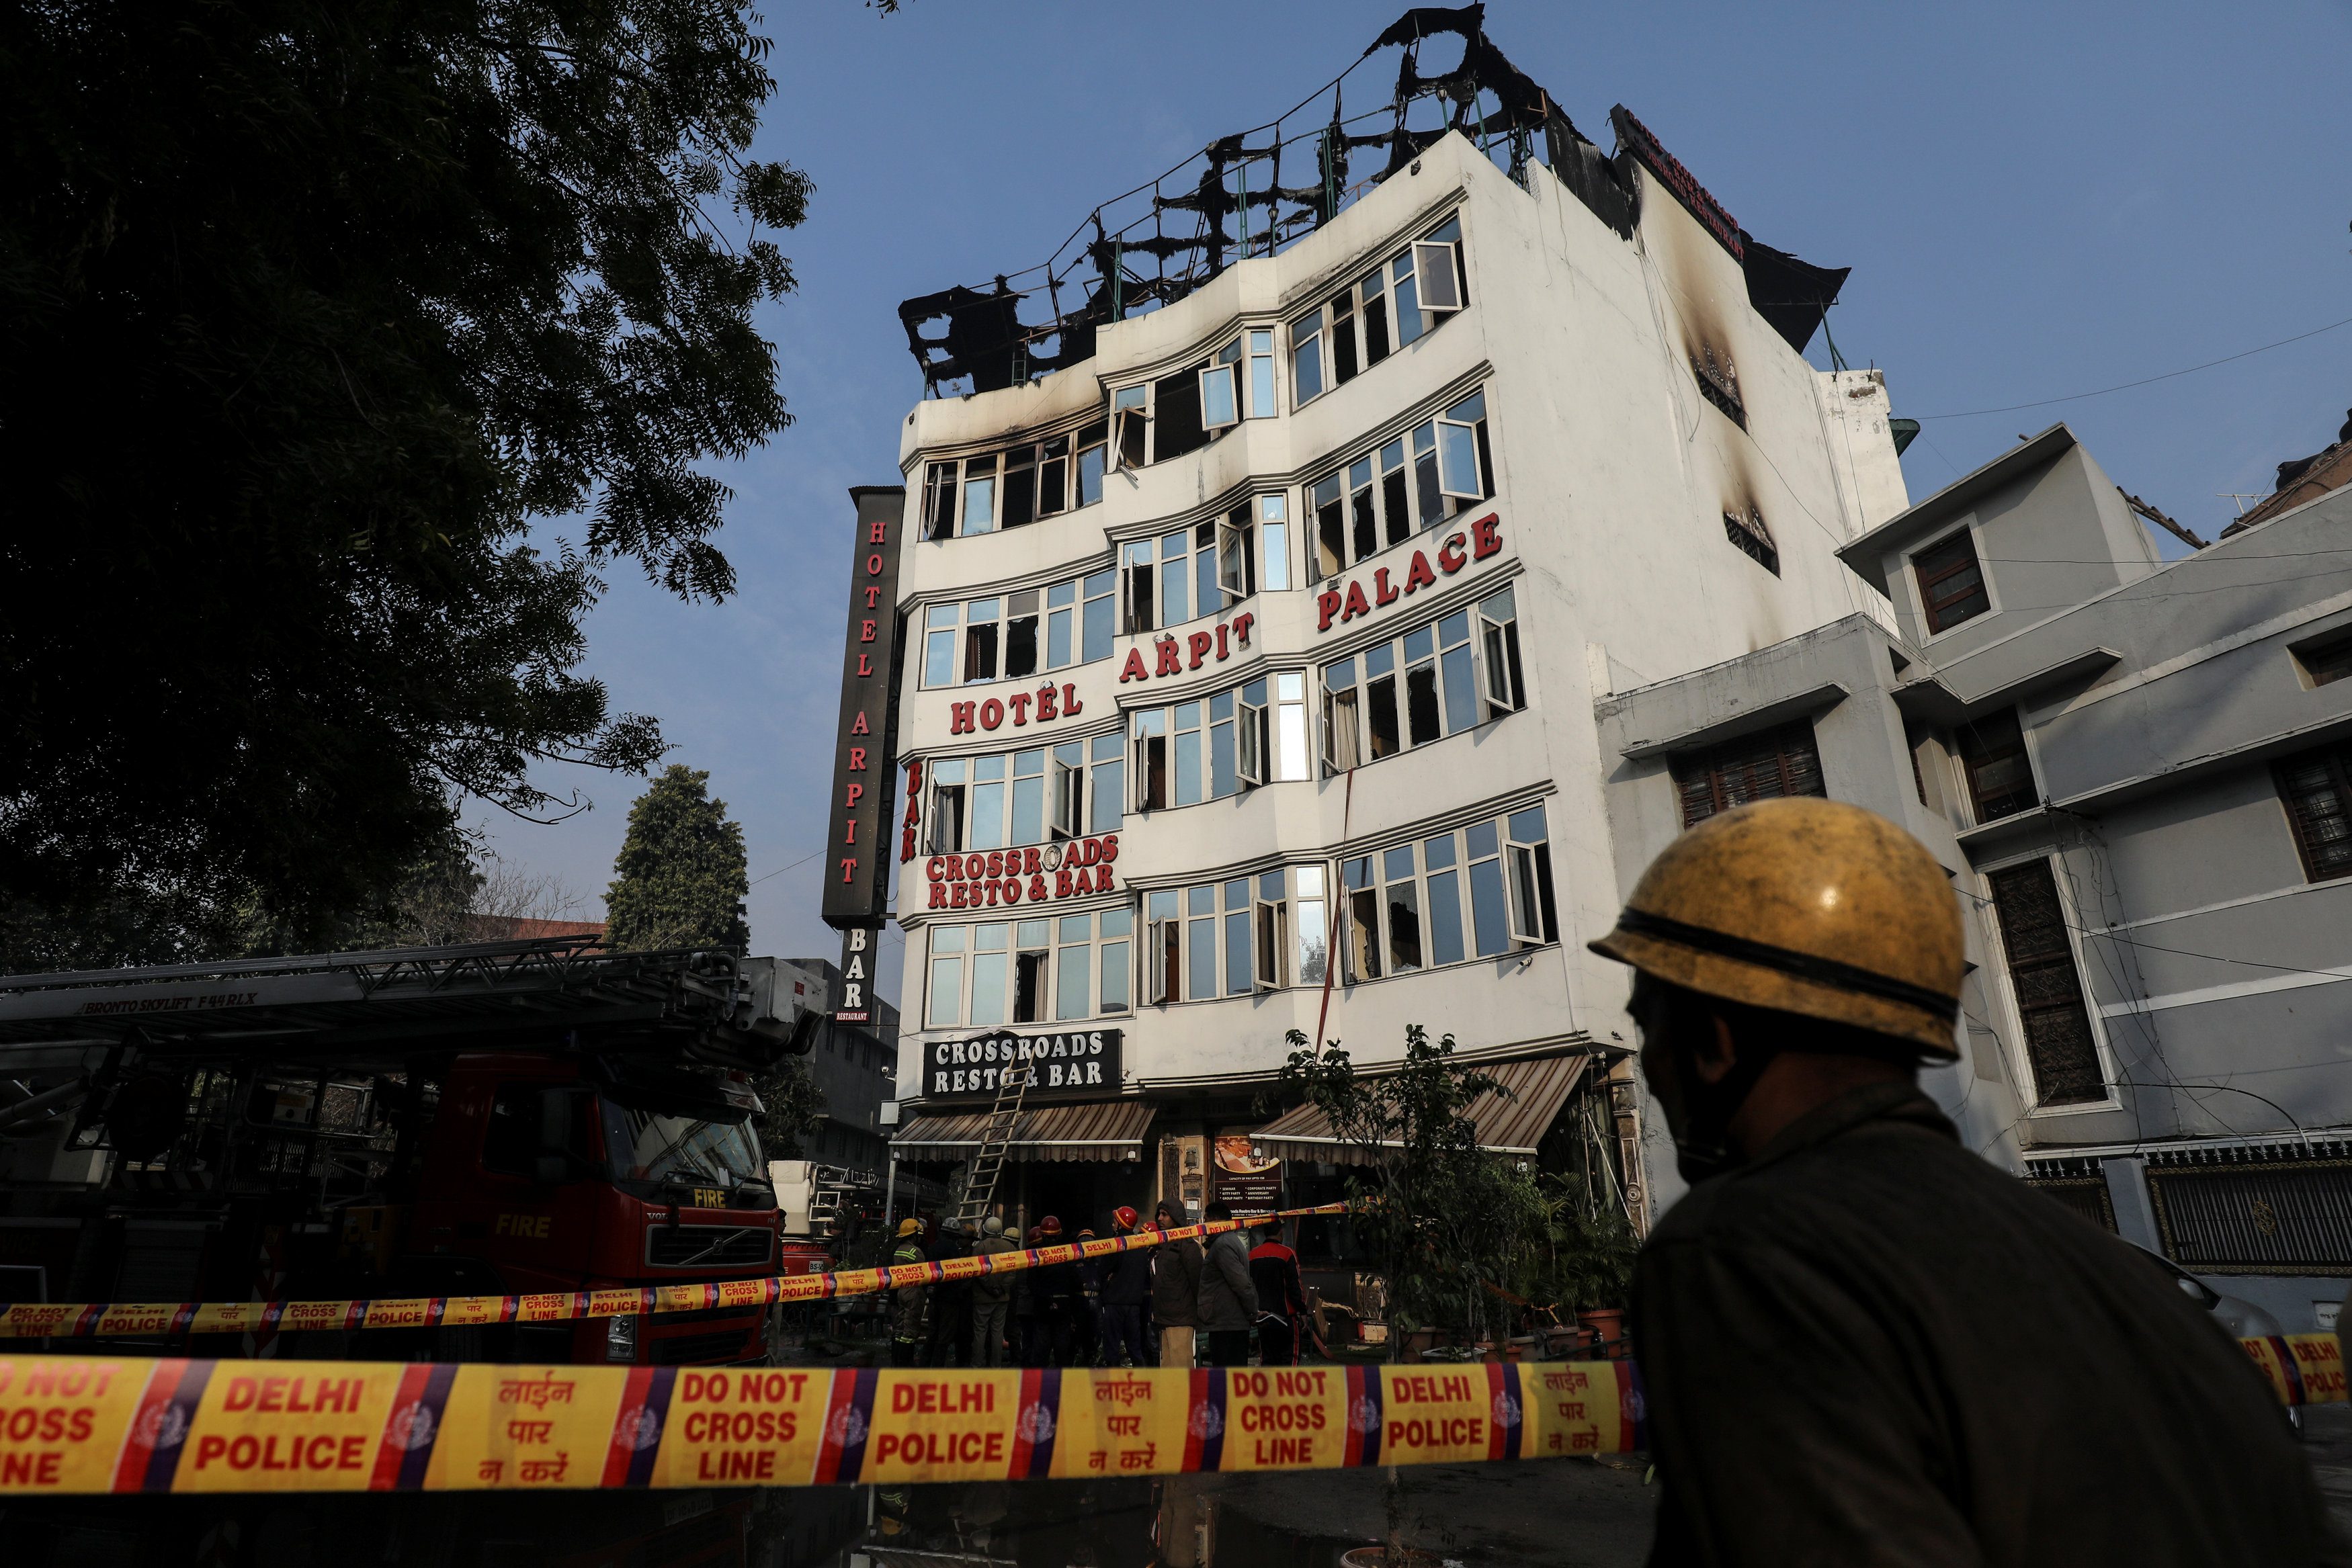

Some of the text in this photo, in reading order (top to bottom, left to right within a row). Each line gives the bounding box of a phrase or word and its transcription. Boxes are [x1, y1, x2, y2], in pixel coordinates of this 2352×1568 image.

[1689, 192, 1745, 261] RESTAURANT
[950, 511, 1503, 735] HOTEL ARPIT PALACE
[841, 522, 886, 883] HOTEL ARPIT
[900, 762, 923, 865] BAR
[926, 835, 1119, 882] CROSSROADS
[927, 864, 1115, 909] RESTO & BAR
[844, 928, 867, 1008] BAR
[85, 1000, 137, 1014] BRONTO
[139, 997, 193, 1011] SKYLIFT
[837, 1012, 868, 1021] RESTAURANT
[935, 1032, 1104, 1065] CROSSROADS
[934, 1061, 1103, 1093] RESTO & BAR
[694, 1188, 726, 1209] FIRE
[495, 1213, 552, 1239] FIRE
[1168, 1228, 1193, 1238] DO NOT
[1210, 1224, 1231, 1233] DELHI
[1043, 1254, 1068, 1264] CROSS
[1086, 1242, 1112, 1252] DELHI
[896, 1272, 925, 1280] CROSS
[945, 1261, 974, 1269] DELHI
[526, 1301, 565, 1309] CROSS
[725, 1287, 759, 1296] CROSS
[730, 1297, 754, 1305] LINE
[782, 1286, 821, 1298] POLICE
[10, 1314, 65, 1323] CROSS
[291, 1309, 337, 1317] CROSS
[368, 1312, 423, 1324] POLICE
[531, 1310, 558, 1321] LINE
[591, 1301, 638, 1313] POLICE
[15, 1324, 54, 1336] LINE
[102, 1318, 168, 1332] POLICE
[296, 1319, 328, 1331] LINE
[2243, 1340, 2266, 1358] OT
[2292, 1342, 2341, 1361] DELHI
[24, 1361, 122, 1398] NOT
[498, 1370, 576, 1410] लाईन
[681, 1373, 809, 1404] DO NOT
[1094, 1372, 1152, 1407] लाईन
[1232, 1371, 1327, 1398] DO NOT
[1392, 1375, 1473, 1404] DELHI
[2304, 1371, 2347, 1393] POLIC
[222, 1377, 366, 1413] DELHI
[890, 1382, 995, 1415] DELHI
[0, 1407, 96, 1443] OSS
[1241, 1403, 1327, 1432] CROSS
[1558, 1402, 1587, 1421] पार
[507, 1420, 554, 1446] पार
[683, 1411, 798, 1444] CROSS
[1107, 1415, 1142, 1437] पार
[1388, 1420, 1484, 1448] POLICE
[1548, 1424, 1600, 1451] न करें
[194, 1434, 368, 1472] POLICE
[875, 1432, 1005, 1465] POLICE
[1089, 1442, 1157, 1471] न करें
[1255, 1438, 1313, 1466] LINE
[0, 1452, 64, 1486] NE
[478, 1448, 569, 1484] न करें
[697, 1450, 778, 1481] LINE
